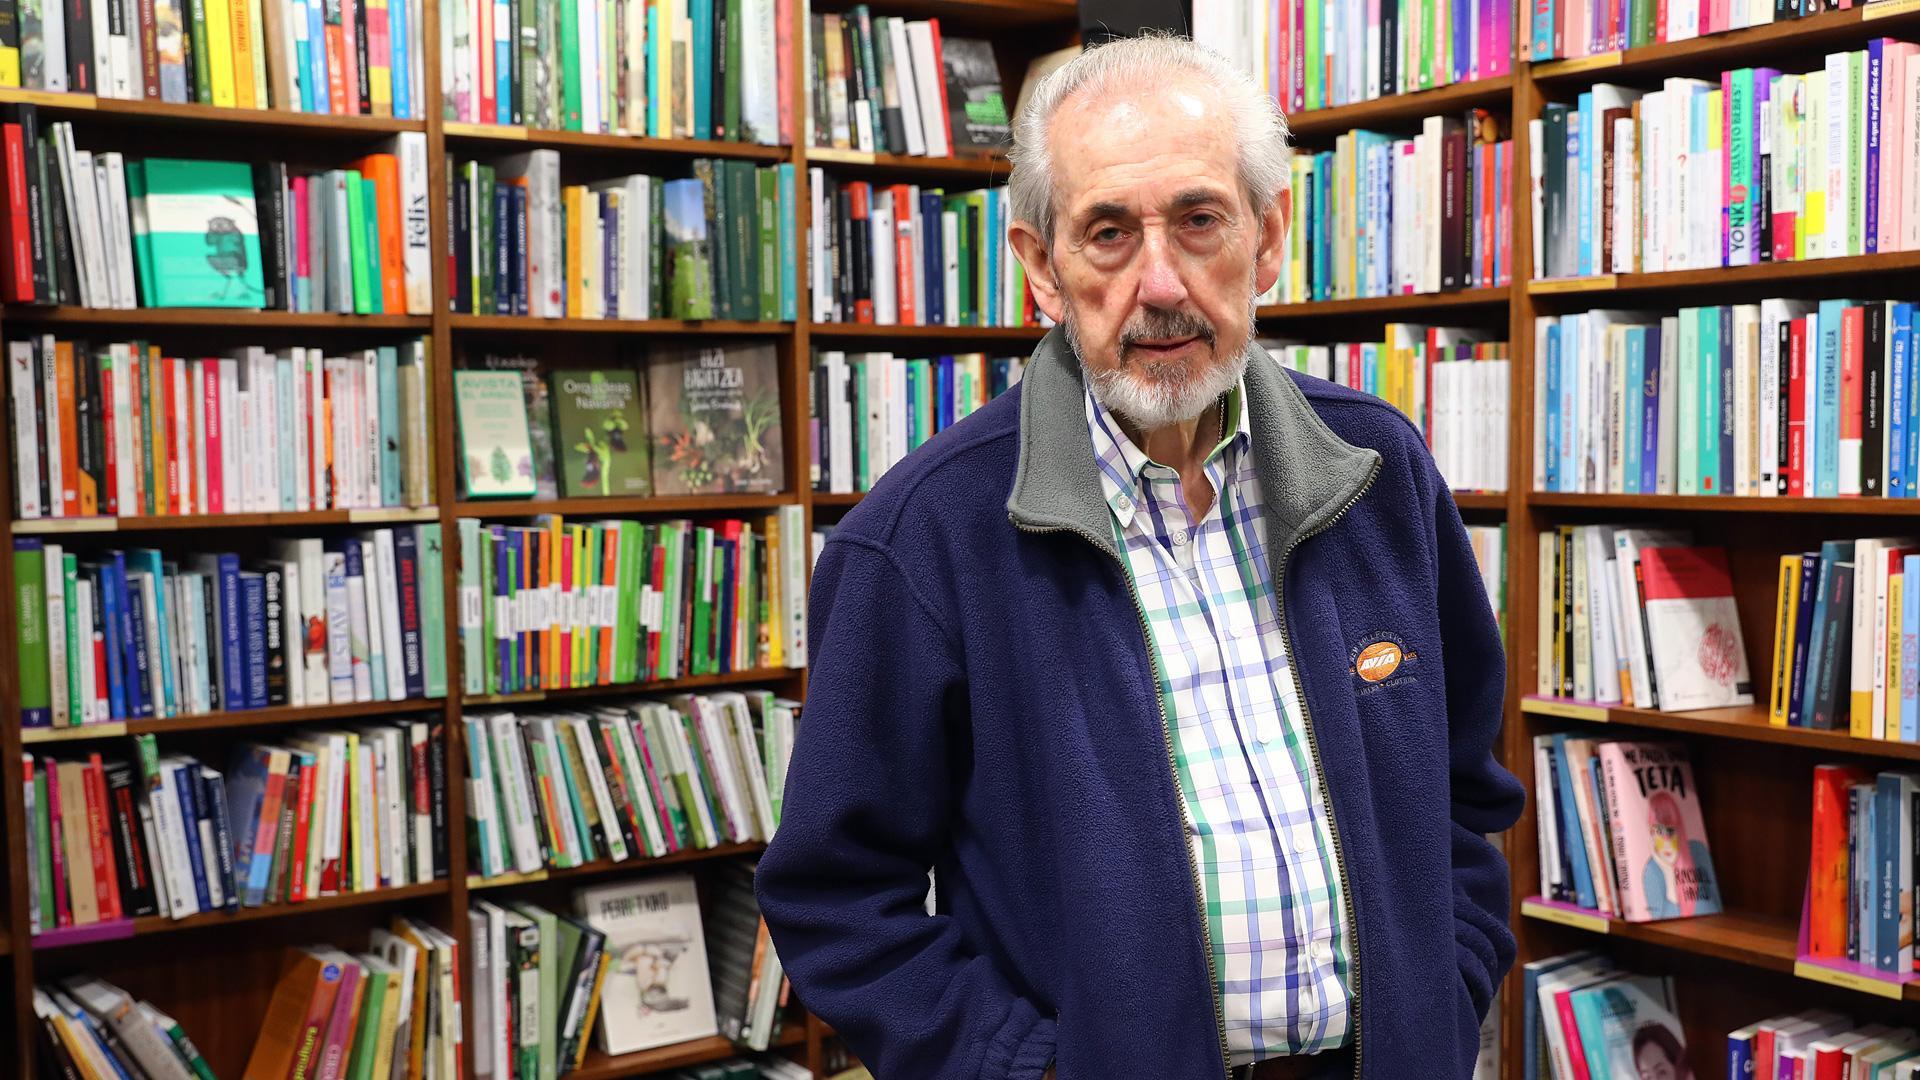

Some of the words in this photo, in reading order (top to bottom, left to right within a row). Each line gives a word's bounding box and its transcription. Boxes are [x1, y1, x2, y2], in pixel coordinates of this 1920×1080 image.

[407, 194, 427, 250] Félix
[1824, 330, 1836, 406] FIBROMIALGIA
[267, 603, 281, 618] de
[330, 609, 349, 656] AVES
[1360, 652, 1396, 670] AVIA
[1634, 766, 1685, 798] TETA
